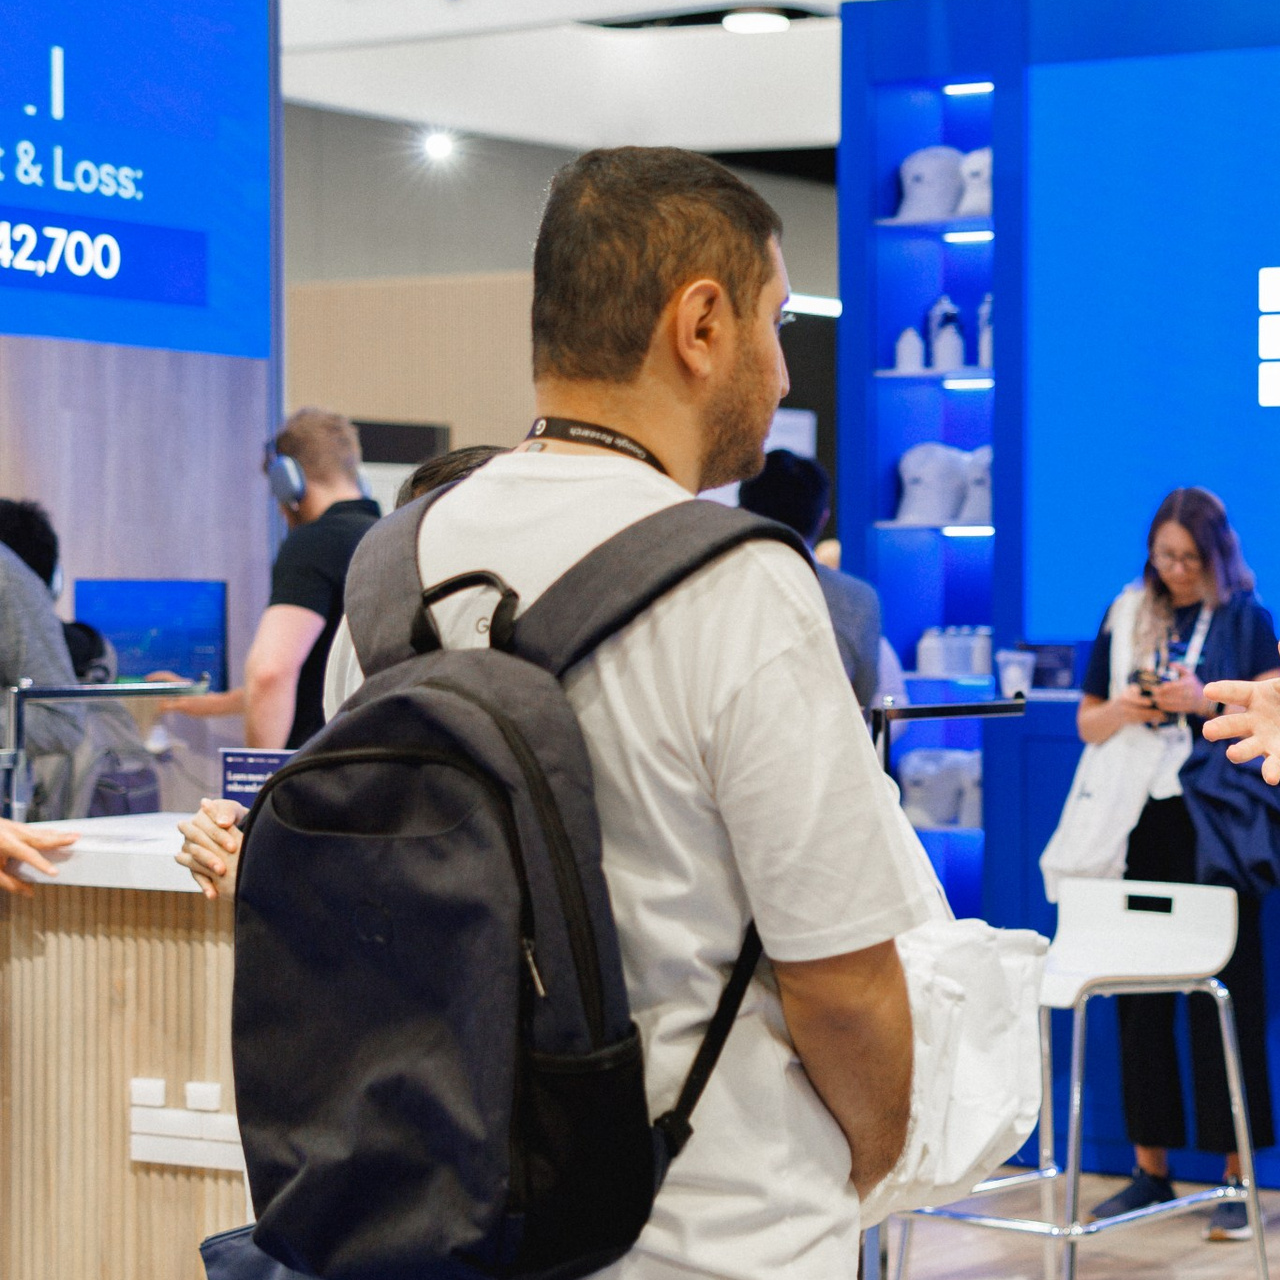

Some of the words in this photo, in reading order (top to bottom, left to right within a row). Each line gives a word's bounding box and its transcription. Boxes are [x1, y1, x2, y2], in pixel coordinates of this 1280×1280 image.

[15, 139, 45, 187] &
[53, 144, 144, 201] Loss:
[569, 426, 614, 445] Research
